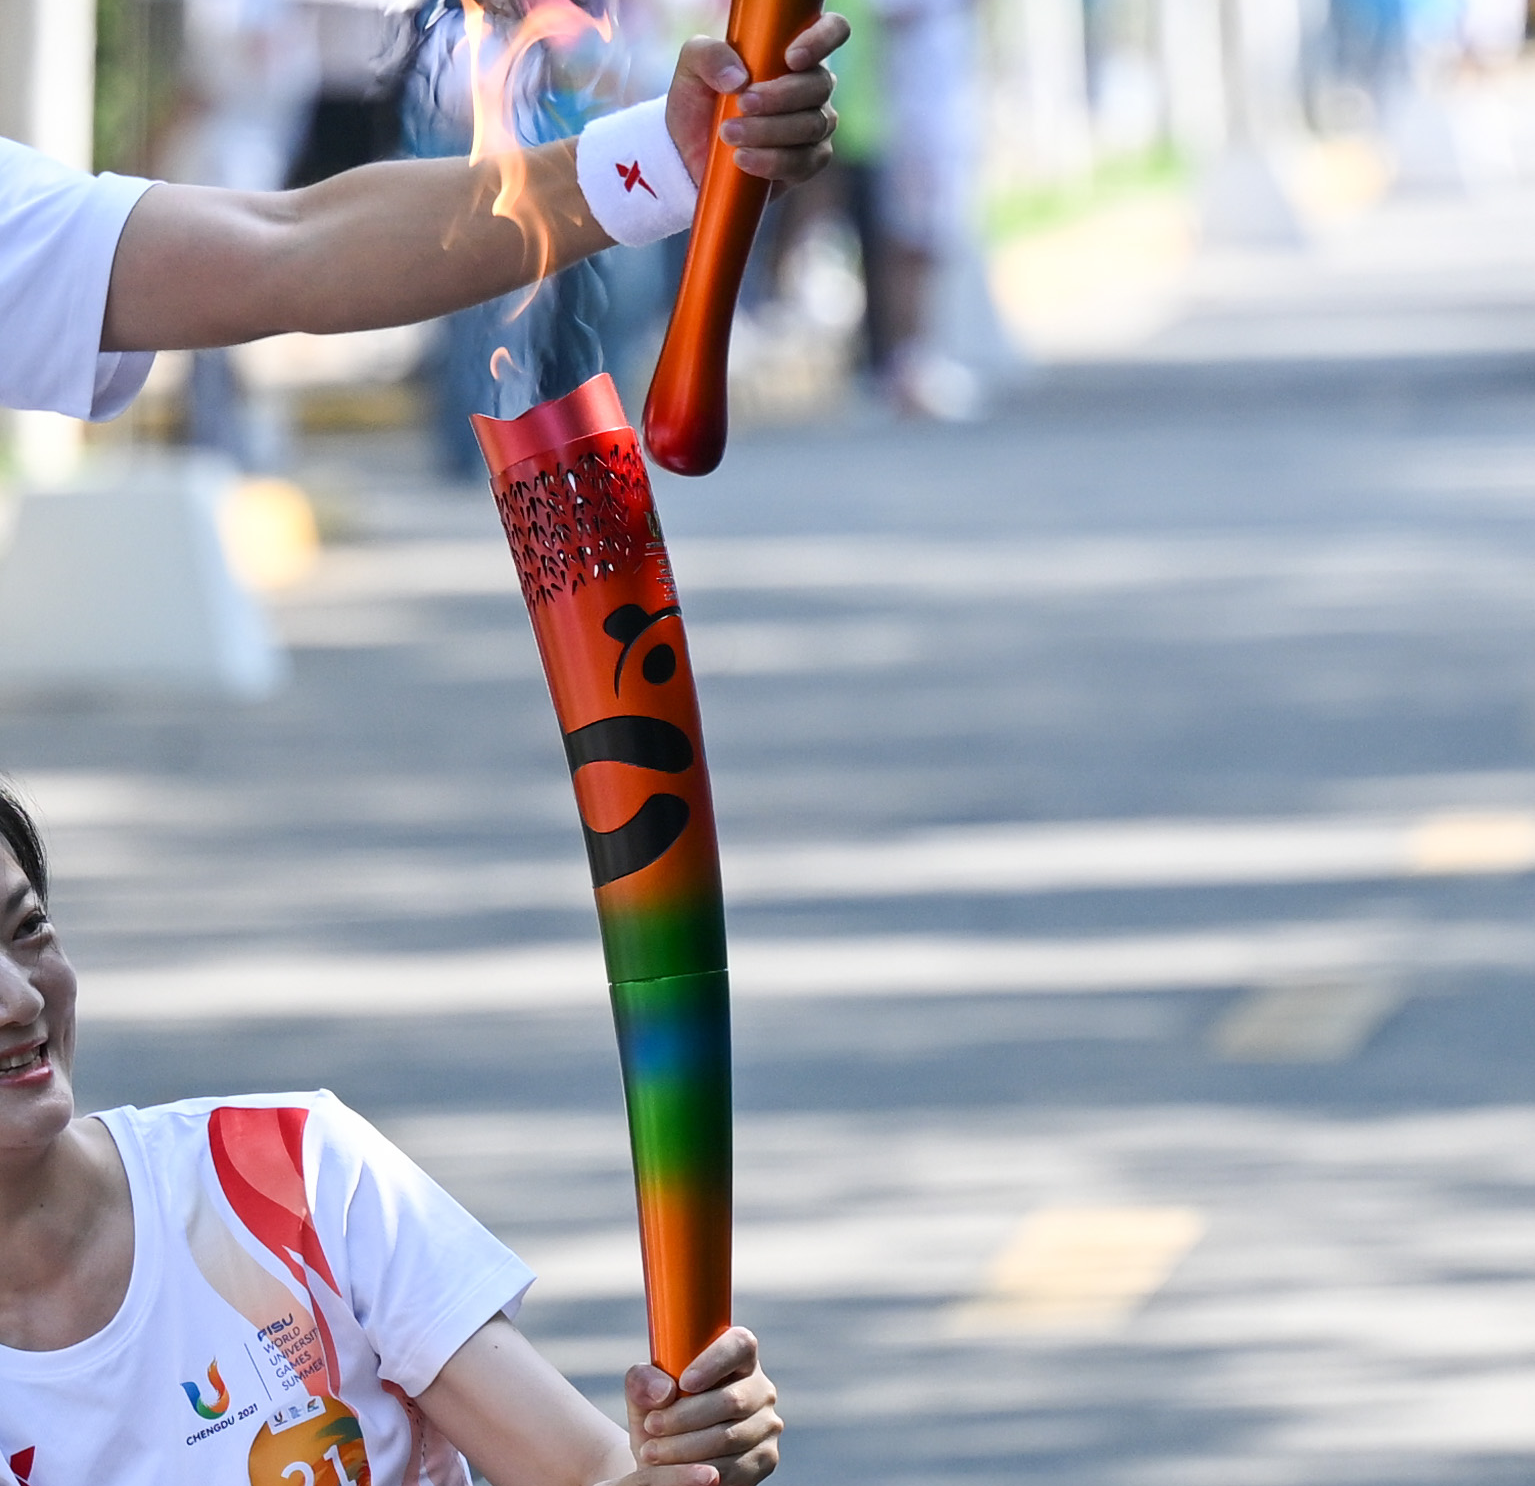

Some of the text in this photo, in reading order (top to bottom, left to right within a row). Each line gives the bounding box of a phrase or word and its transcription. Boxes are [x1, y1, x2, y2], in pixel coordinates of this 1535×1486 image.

[257, 1313, 294, 1342] FISU
[263, 1326, 301, 1354] WORLD
[269, 1327, 319, 1366] UNIVERSIT
[276, 1350, 312, 1378] GAMES
[281, 1358, 325, 1391] SUMMER
[186, 1415, 235, 1446] CHENGDU
[238, 1403, 259, 1421] 2021
